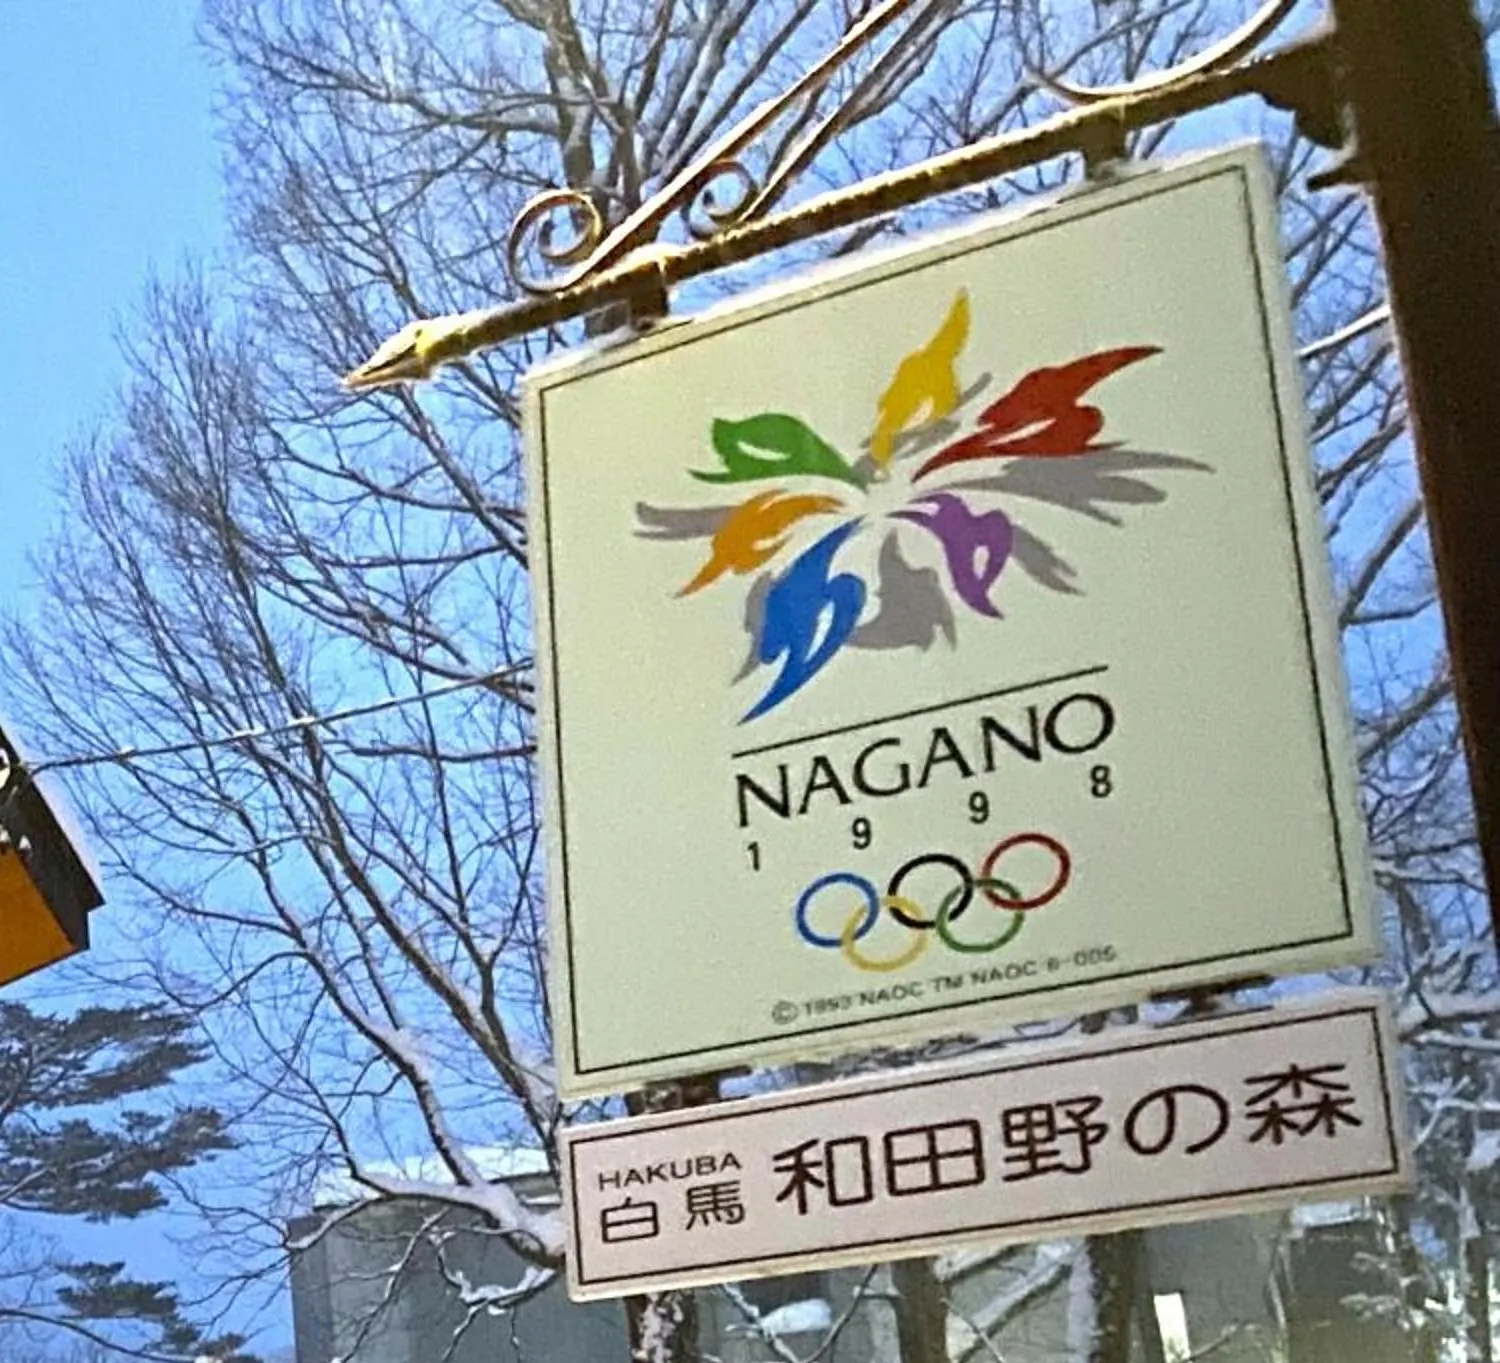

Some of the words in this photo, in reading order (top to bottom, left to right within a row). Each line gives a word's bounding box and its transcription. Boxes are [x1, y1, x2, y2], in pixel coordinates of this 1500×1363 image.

[735, 692, 1115, 828] NAGANO
[859, 980, 924, 1006] NAOC
[970, 960, 1038, 987] NAOC
[771, 1062, 1363, 1216] 和田野の森
[598, 1151, 743, 1192] HAKUBA
[600, 1179, 746, 1243] 白馬
